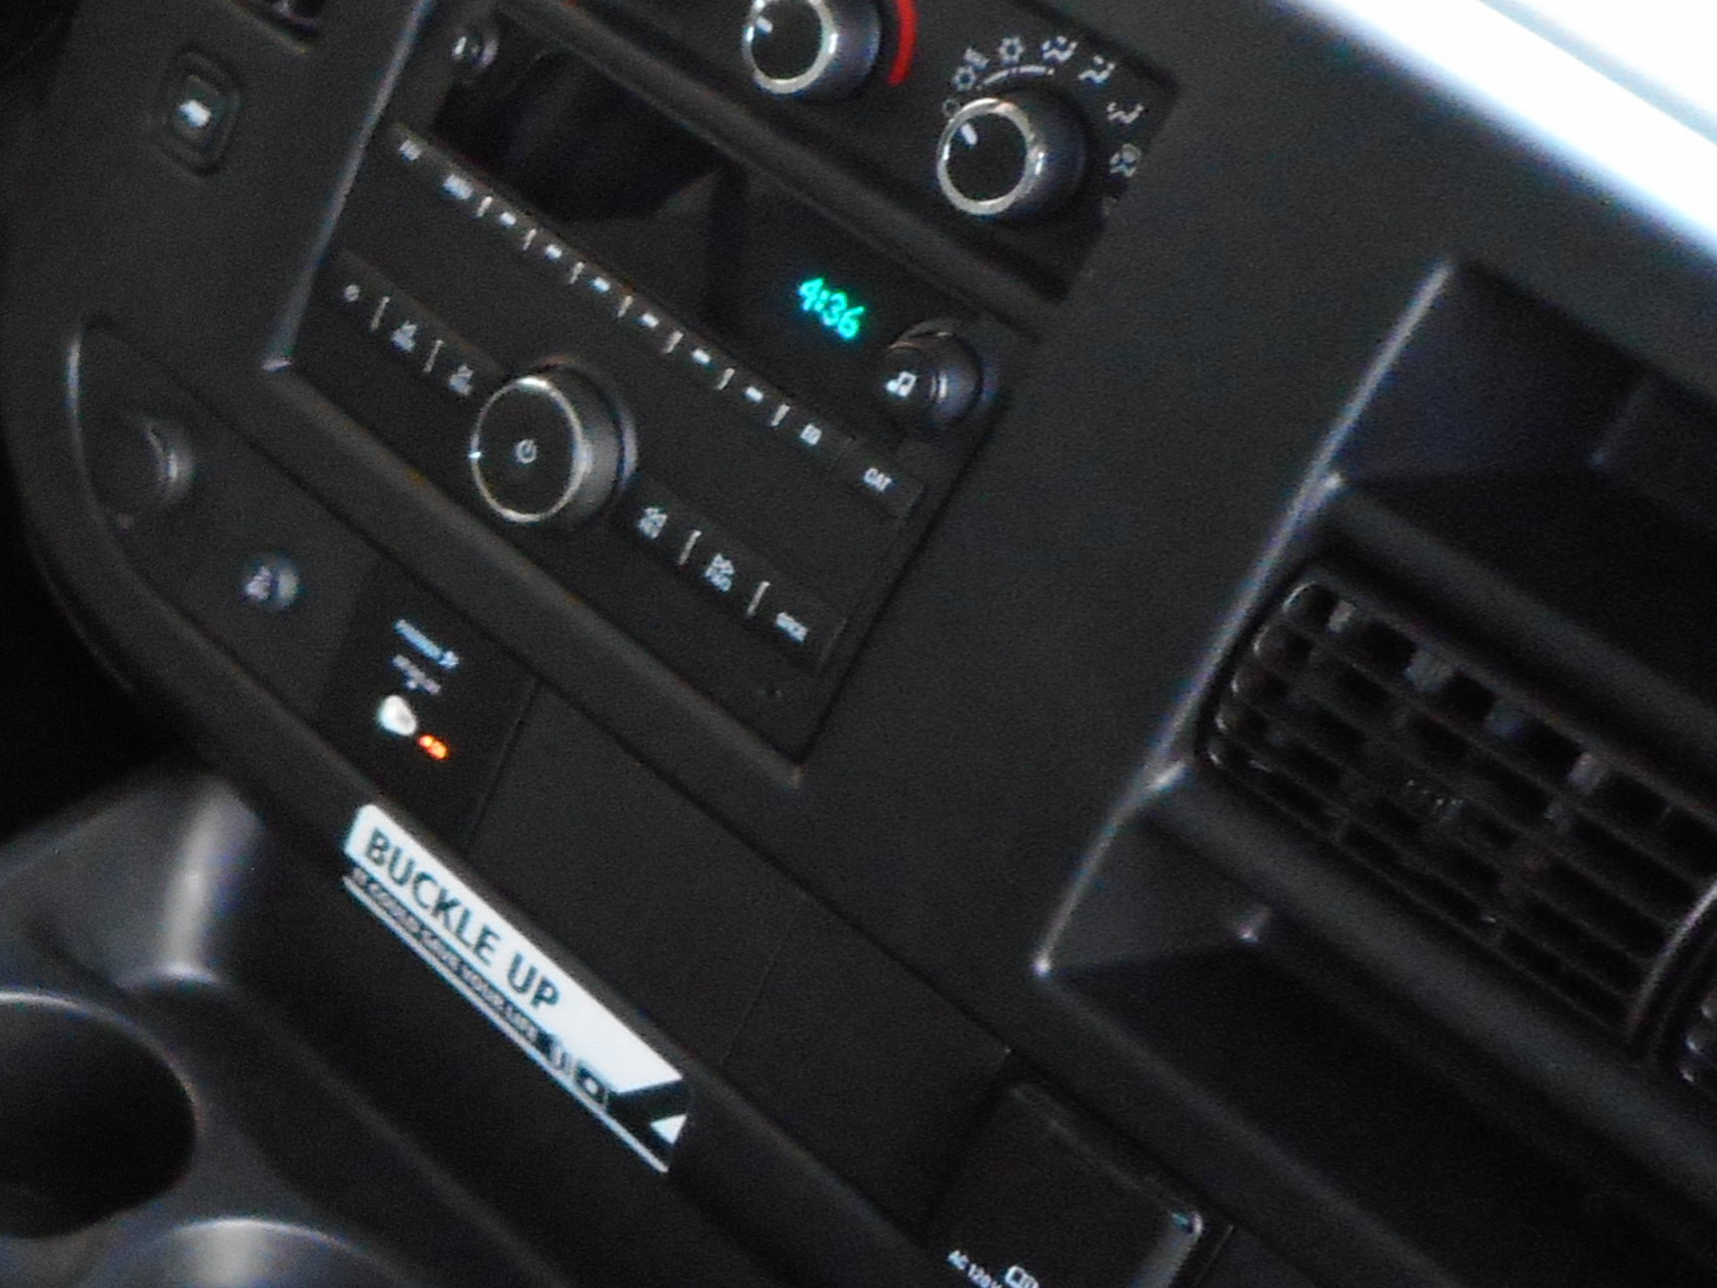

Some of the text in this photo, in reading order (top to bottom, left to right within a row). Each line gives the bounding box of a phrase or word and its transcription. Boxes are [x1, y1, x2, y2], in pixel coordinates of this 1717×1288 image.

[798, 277, 865, 339] 4:36
[365, 827, 559, 1009] BUCKLE UP
